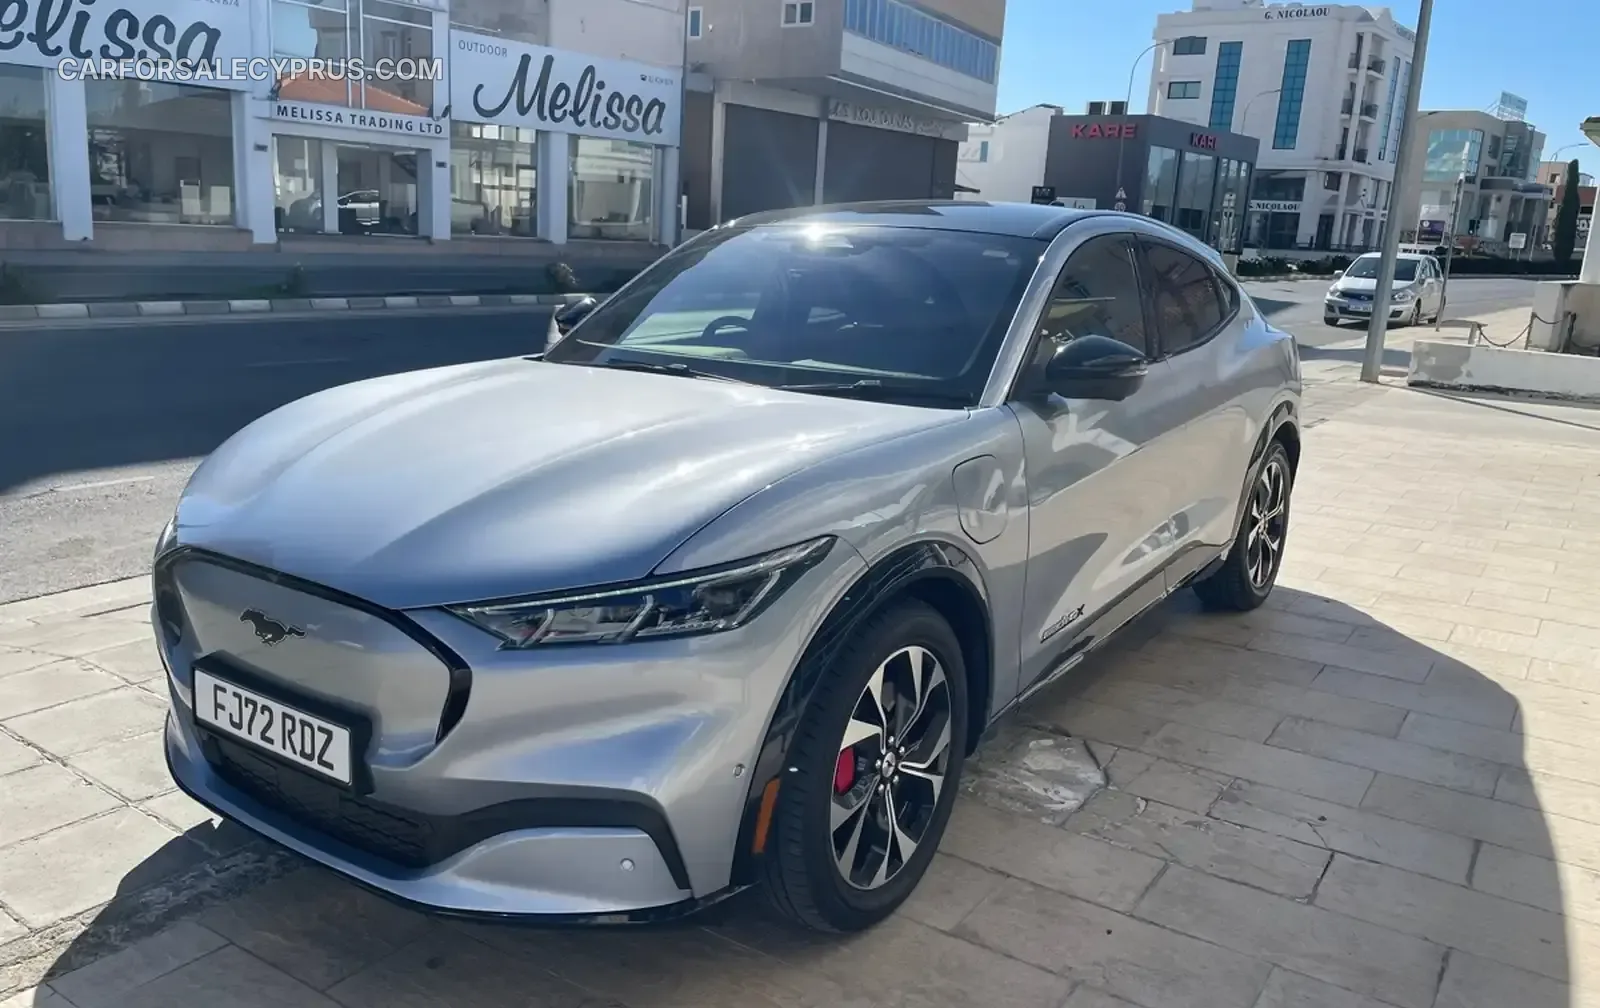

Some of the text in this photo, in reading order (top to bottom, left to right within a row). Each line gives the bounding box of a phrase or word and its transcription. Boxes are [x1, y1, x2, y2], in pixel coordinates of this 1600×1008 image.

[1277, 7, 1331, 19] NICOLAOU
[458, 39, 508, 57] OUTDOOR
[472, 53, 666, 136] Melissa
[276, 104, 443, 135] MELISSA TRADING LTD
[1071, 123, 1138, 139] KARE
[213, 684, 335, 771] FJ72 RDZ
